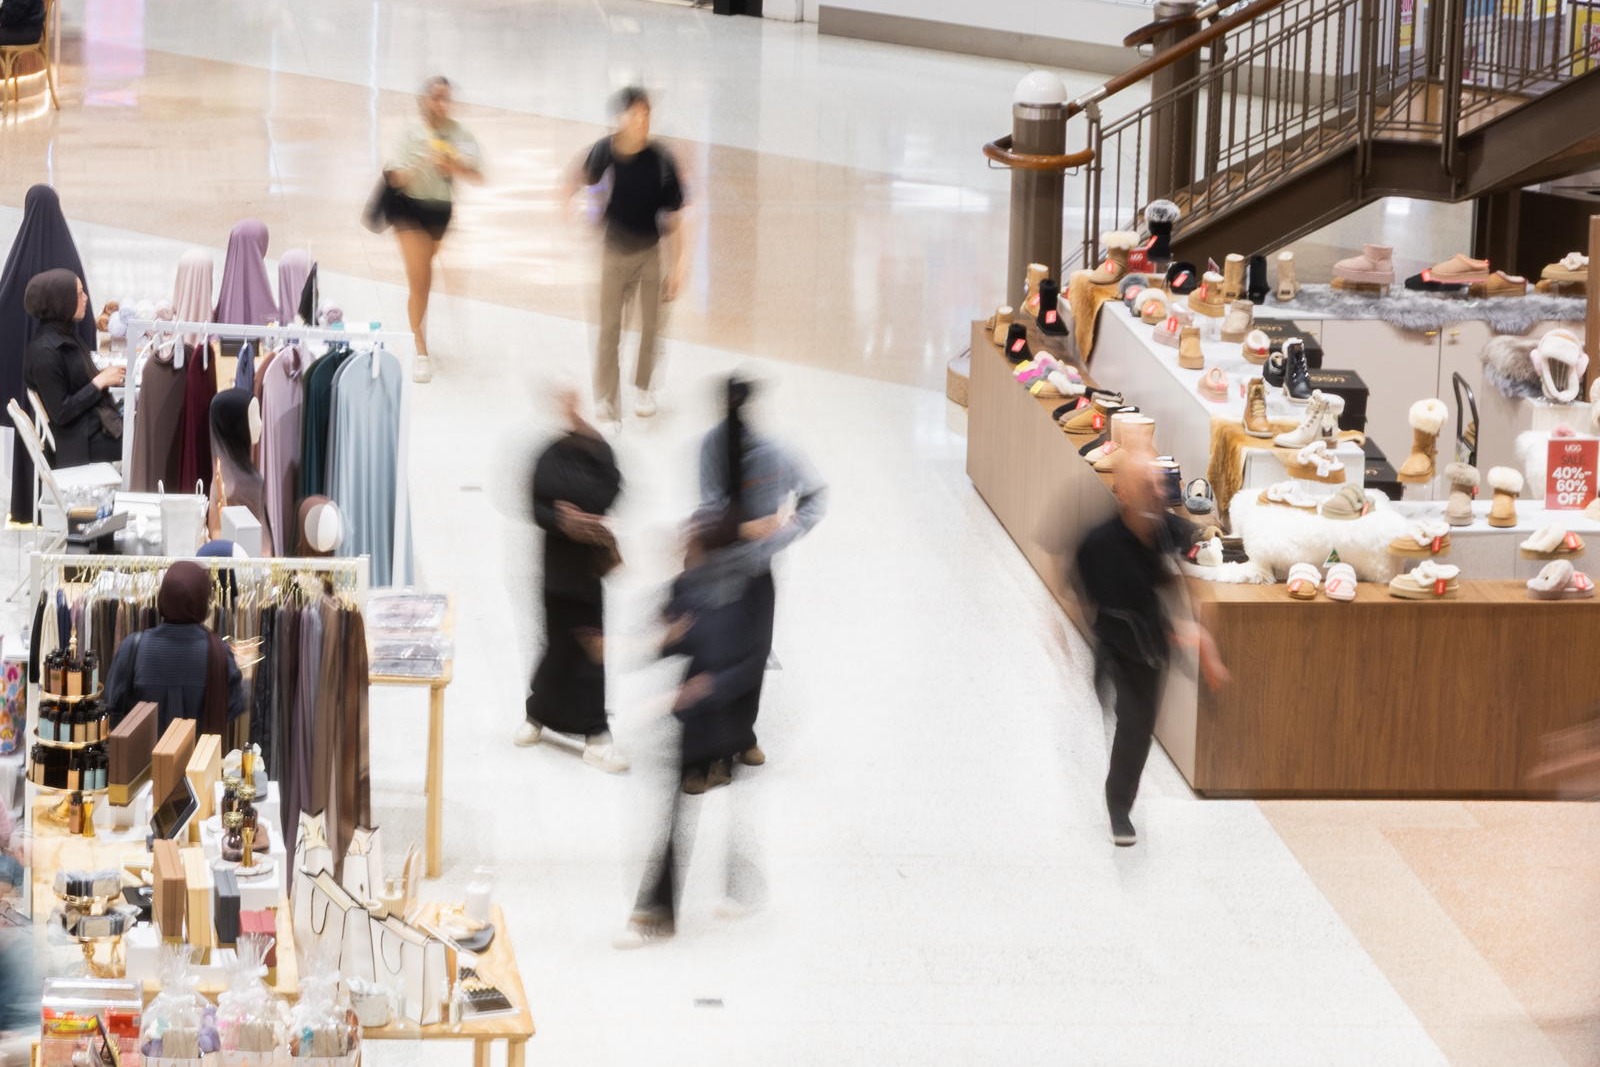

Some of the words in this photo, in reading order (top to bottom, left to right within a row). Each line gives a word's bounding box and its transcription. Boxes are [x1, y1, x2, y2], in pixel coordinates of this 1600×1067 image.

[1130, 253, 1144, 261] UGG
[1564, 444, 1582, 453] UGG
[1561, 454, 1585, 466] SALE
[1556, 479, 1588, 493] 60%
[1557, 492, 1587, 506] OFF
